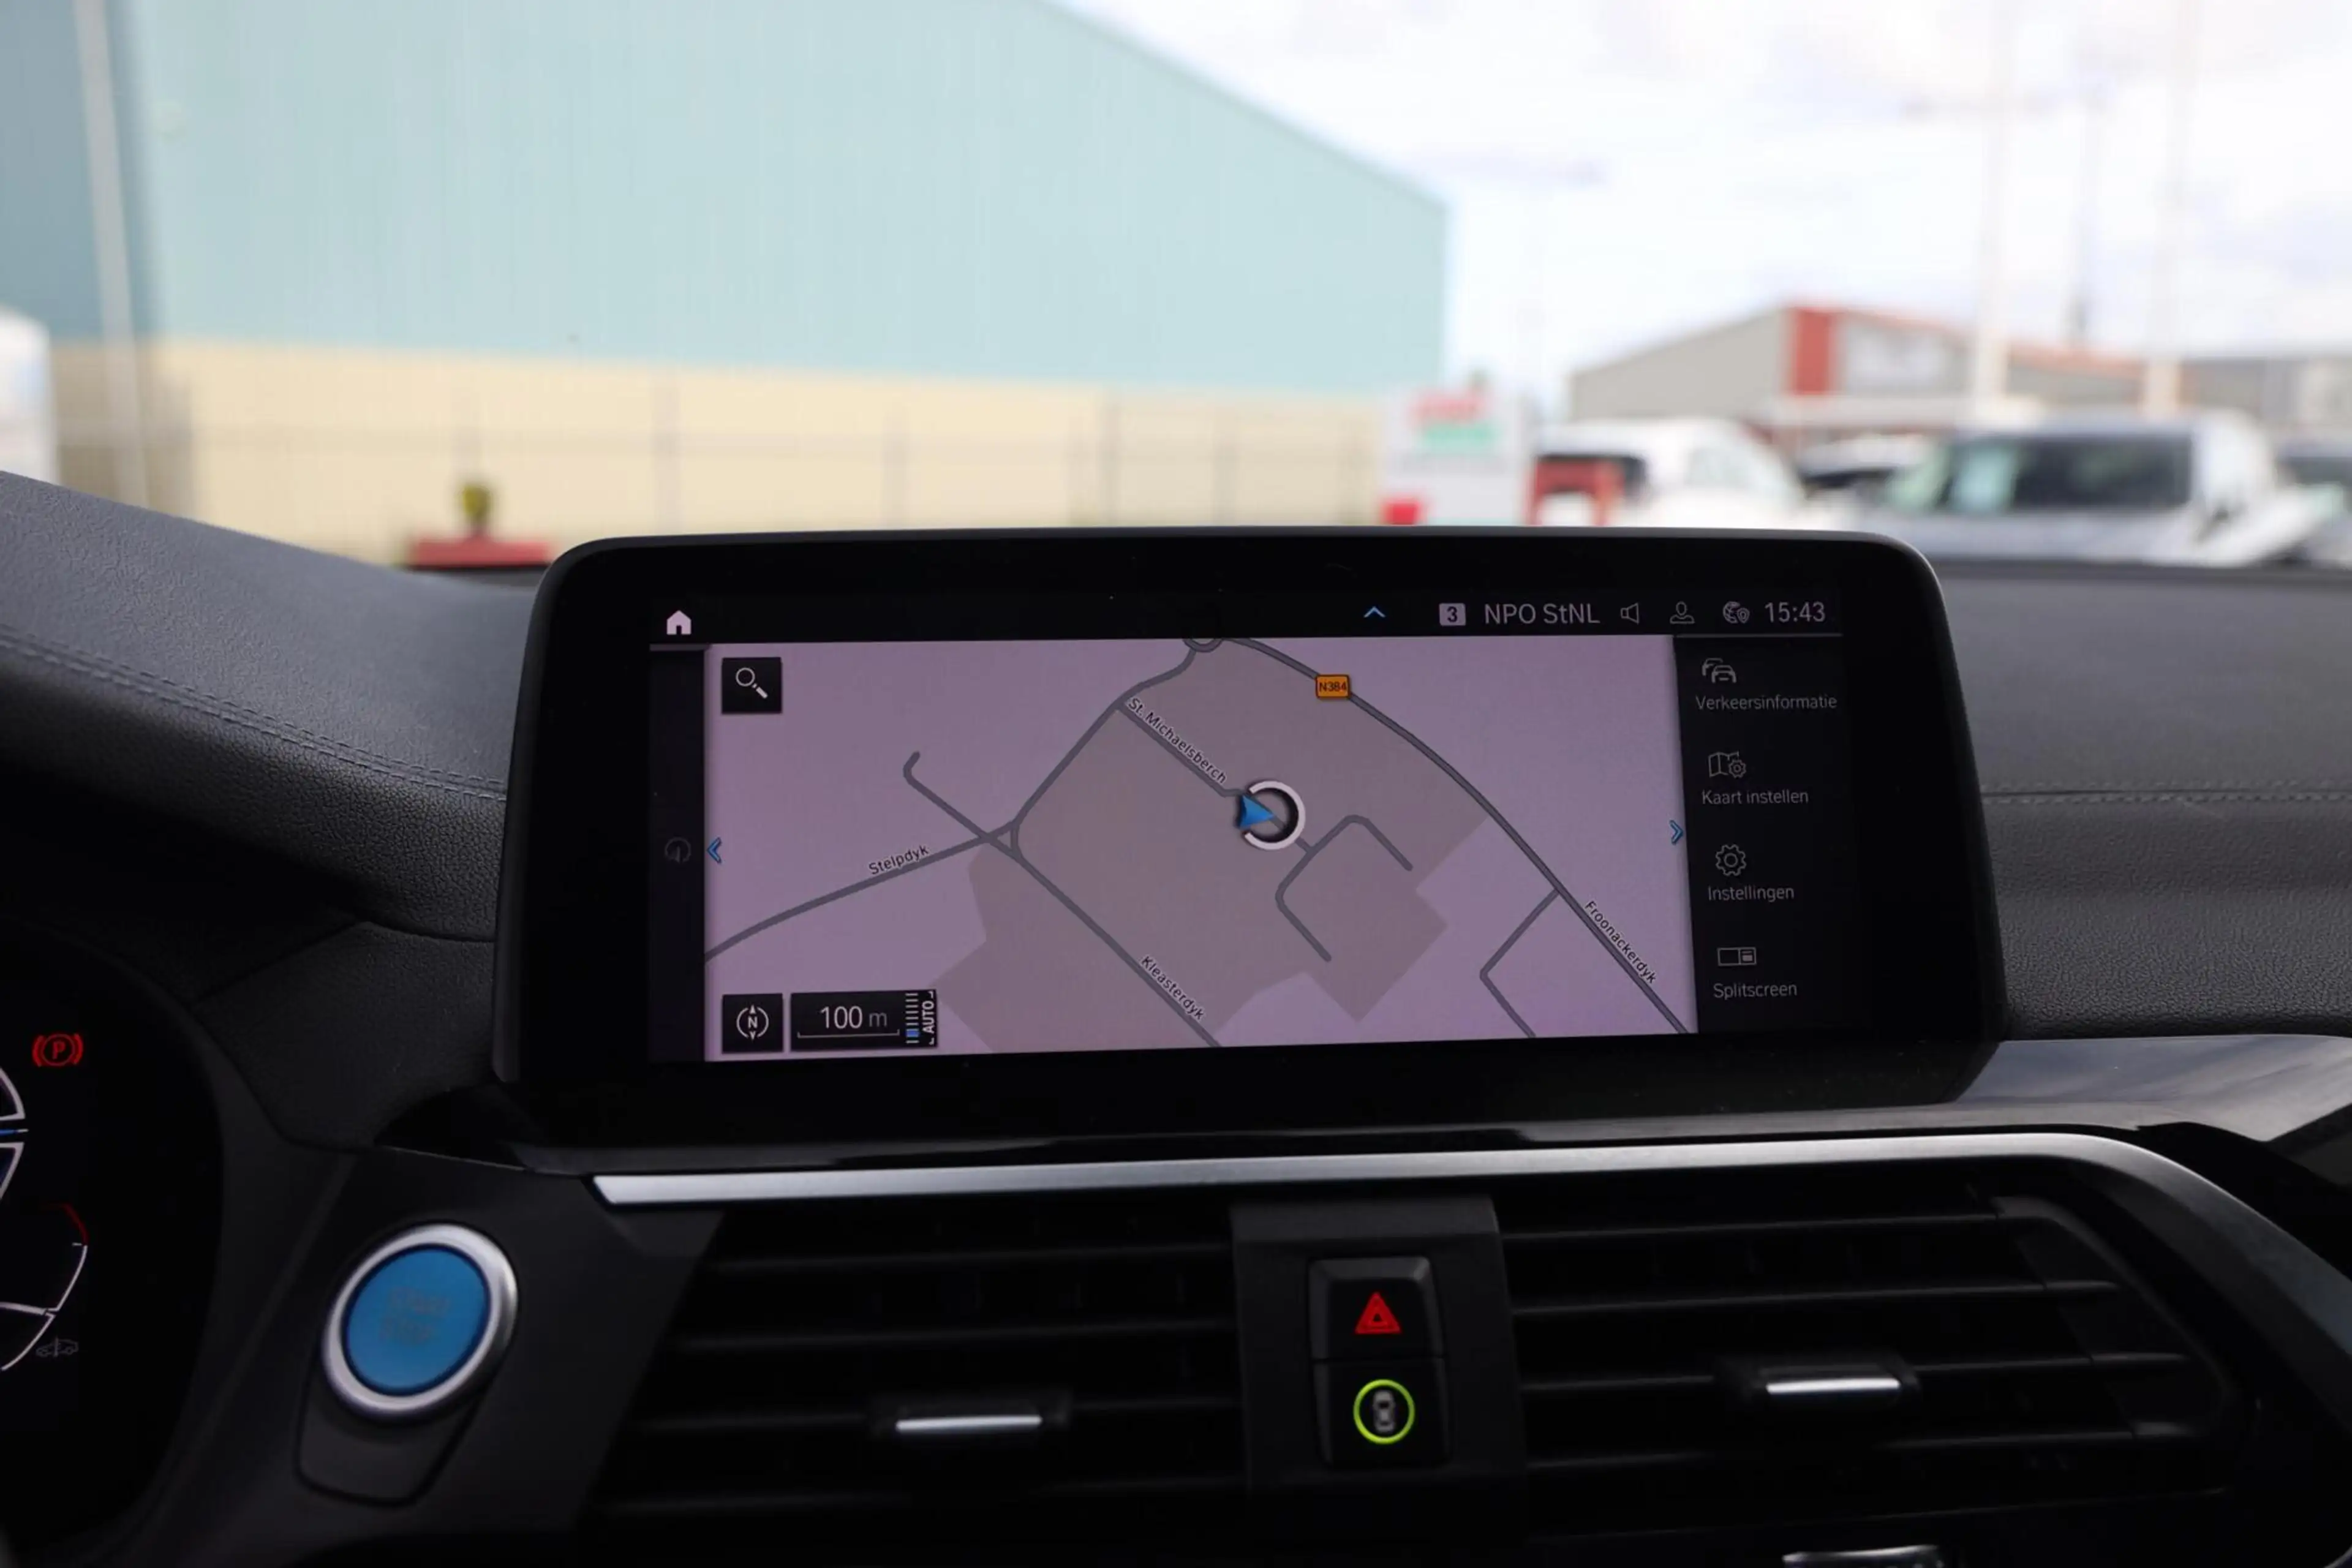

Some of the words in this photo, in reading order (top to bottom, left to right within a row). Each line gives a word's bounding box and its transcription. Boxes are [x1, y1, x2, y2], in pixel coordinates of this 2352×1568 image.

[1446, 606, 1458, 622] 3
[1484, 603, 1536, 624] NPO
[1543, 603, 1600, 624] StNL
[1764, 601, 1826, 623] 15:43
[1319, 681, 1348, 693] N384
[1695, 694, 1838, 712] Verkeersinformatie
[1128, 697, 1144, 717] St.
[1145, 711, 1227, 783] Michaelsberch
[1702, 790, 1743, 805] Kaart
[1746, 789, 1809, 805] instellen
[869, 845, 929, 875] Stelpdyk
[1708, 885, 1795, 903] Instellingen
[1585, 900, 1657, 984] Froonackerdyk
[1141, 956, 1204, 1020] Kleasterdyk
[1713, 982, 1798, 1000] Splitscreen
[748, 1016, 758, 1028] N
[820, 1006, 863, 1030] 100
[869, 1011, 888, 1028] m
[922, 1000, 935, 1034] AUTO
[53, 1041, 66, 1060] P
